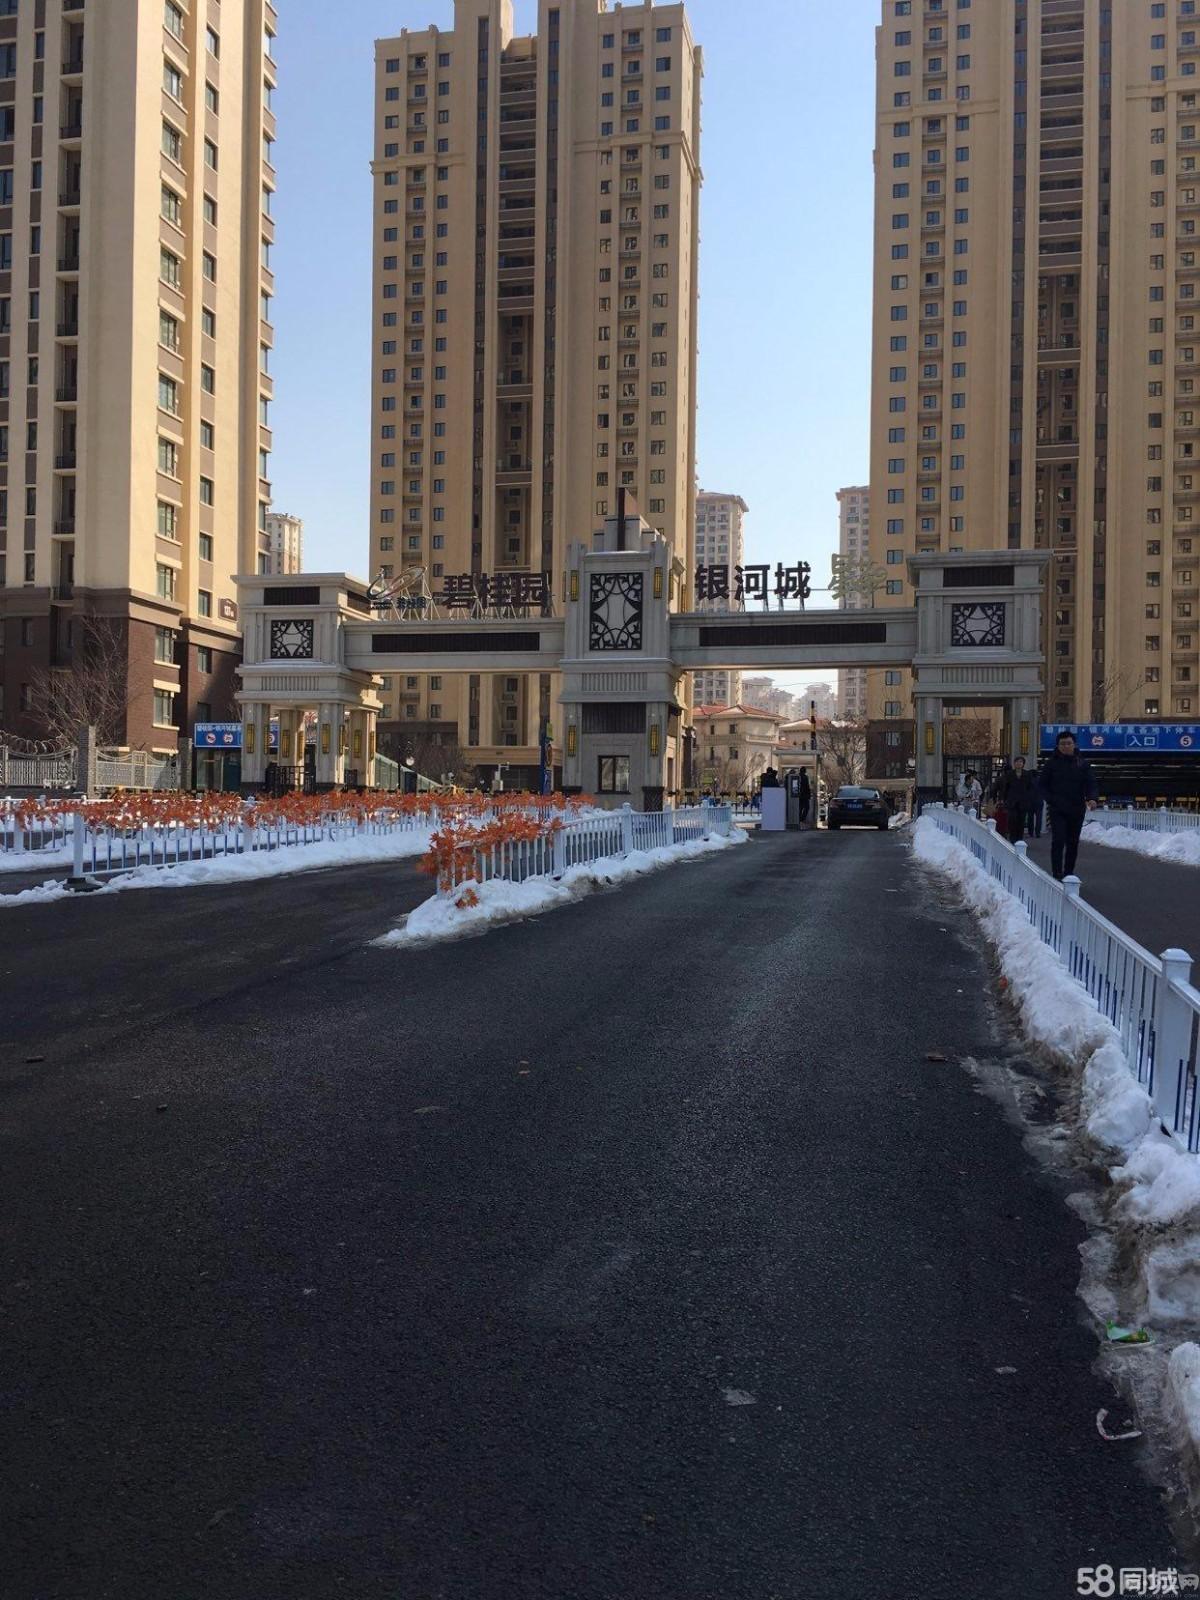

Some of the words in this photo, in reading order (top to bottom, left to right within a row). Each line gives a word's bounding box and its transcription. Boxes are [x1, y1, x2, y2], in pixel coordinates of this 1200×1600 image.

[442, 572, 548, 609] 碧桂园
[694, 561, 811, 601] 银河城
[1128, 735, 1156, 747] 入口
